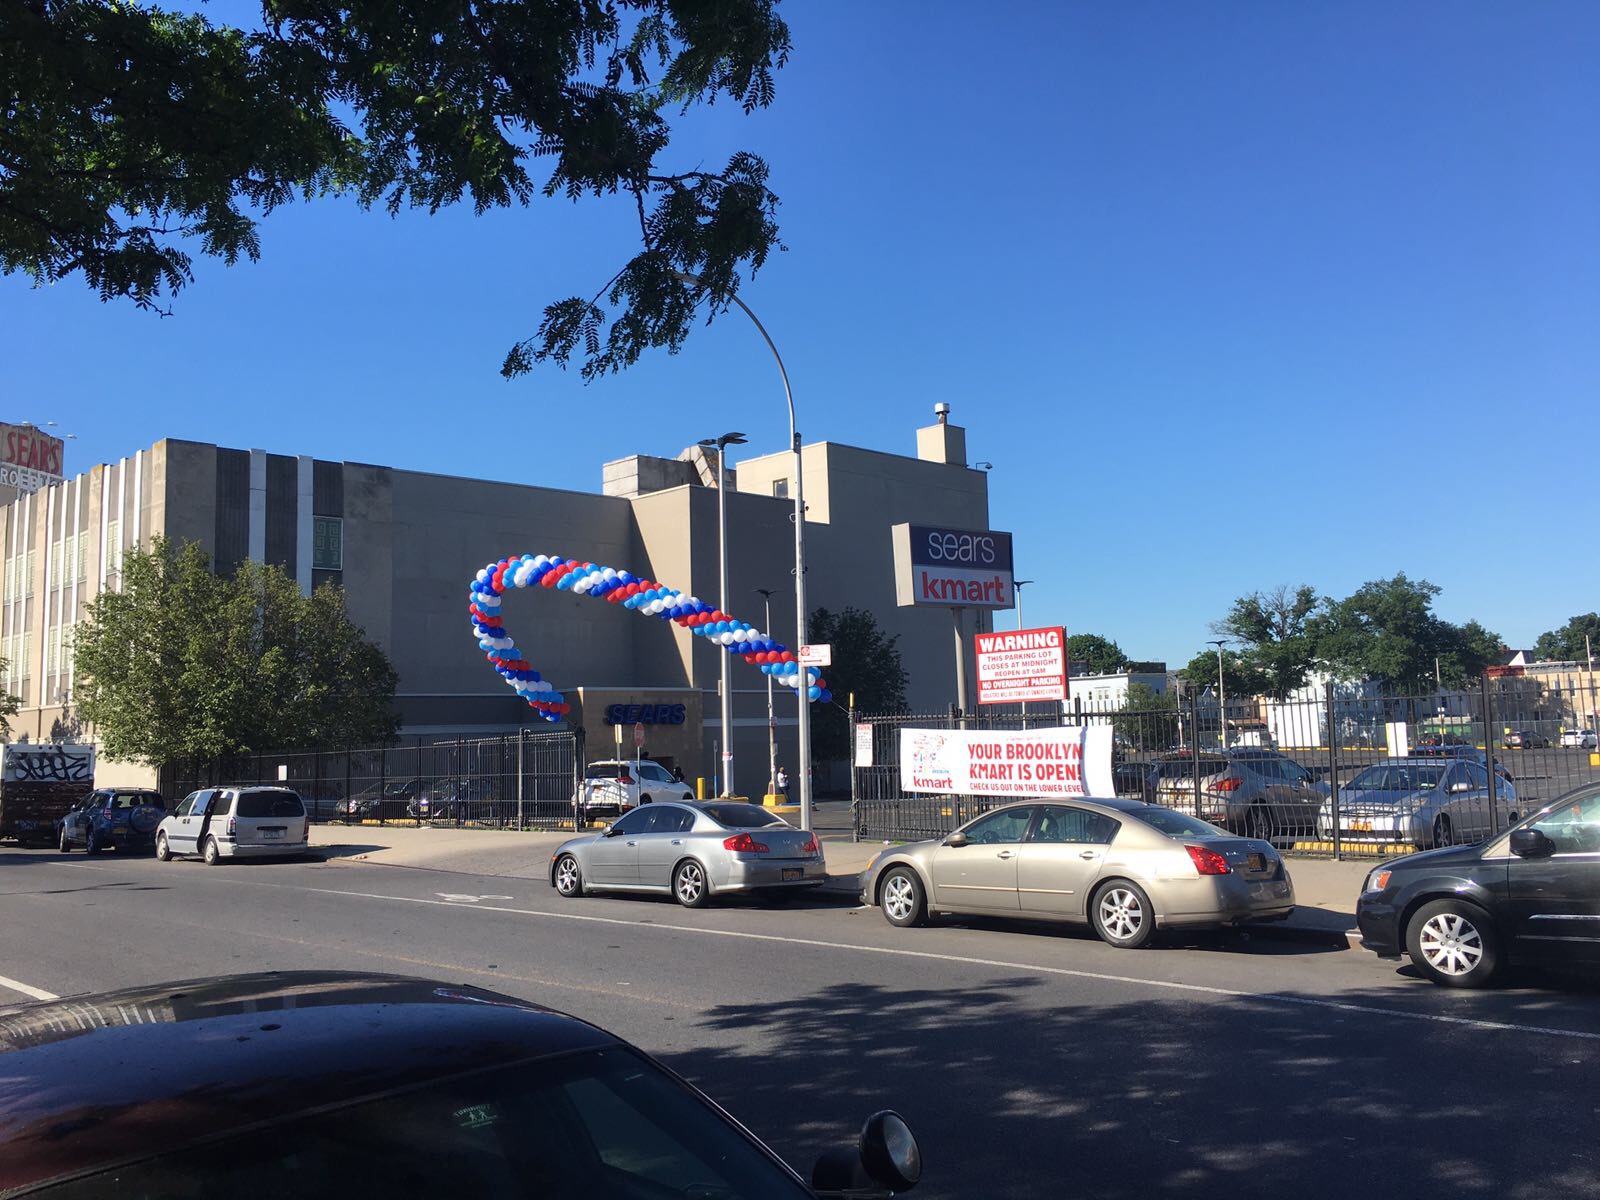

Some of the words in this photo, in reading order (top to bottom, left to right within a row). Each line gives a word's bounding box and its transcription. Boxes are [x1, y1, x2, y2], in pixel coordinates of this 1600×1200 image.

[6, 431, 61, 475] SEARS
[928, 532, 995, 563] sears
[922, 571, 1005, 603] kmart
[980, 631, 1059, 653] WARNING
[982, 663, 1010, 671] CLOSES
[1021, 658, 1058, 667] MIDNIGHT
[1004, 652, 1037, 661] PARKING
[1038, 650, 1052, 658] LOT
[982, 681, 992, 690] NO
[993, 679, 1030, 689] OVERNIGHT
[1031, 677, 1061, 686] PARKING
[607, 703, 686, 725] SEARS
[967, 743, 1003, 760] YOUR
[1006, 743, 1083, 761] BROOKLYN
[969, 763, 1014, 780] KMART
[1018, 764, 1032, 780] IS
[1035, 764, 1082, 781] OPEN!
[913, 775, 953, 789] kmart
[969, 782, 989, 791] CHECK
[990, 783, 1000, 791] US
[1000, 783, 1013, 792] OUT
[1013, 783, 1024, 792] ON
[1024, 784, 1038, 792] THE
[1038, 784, 1063, 793] LOWER
[1064, 785, 1085, 793] LEVEL
